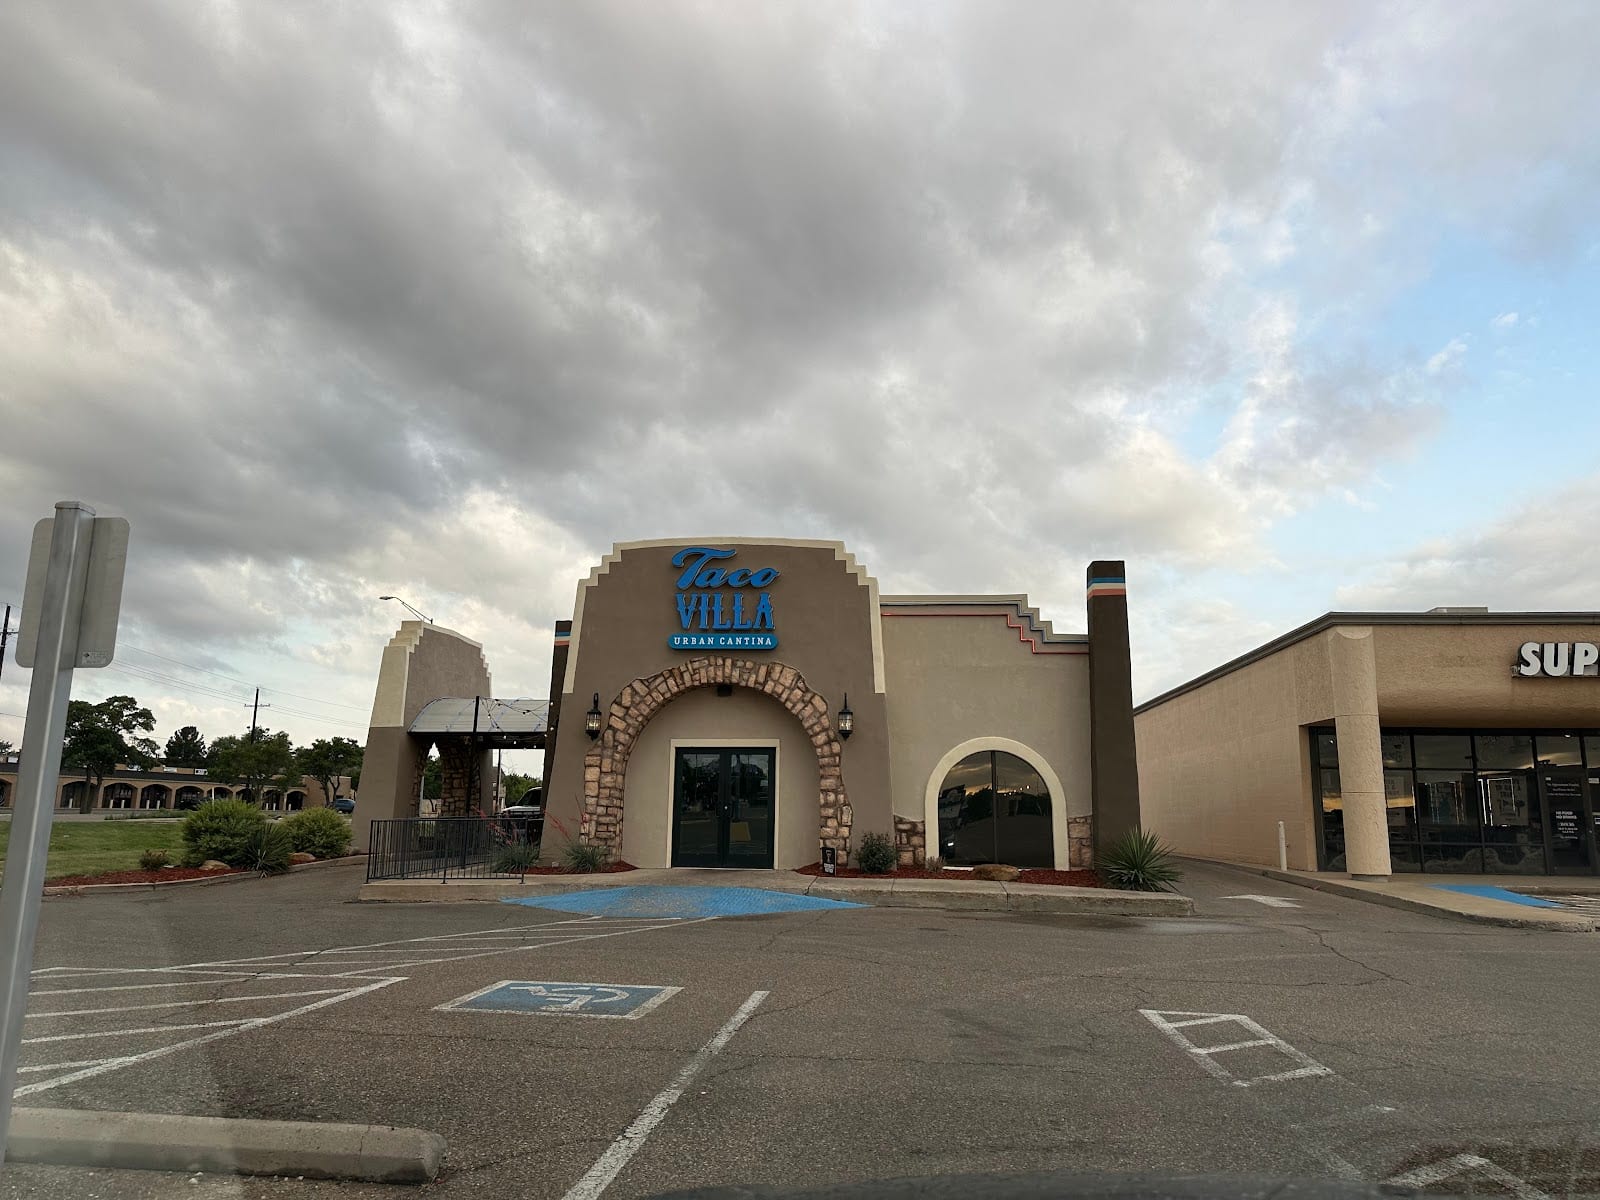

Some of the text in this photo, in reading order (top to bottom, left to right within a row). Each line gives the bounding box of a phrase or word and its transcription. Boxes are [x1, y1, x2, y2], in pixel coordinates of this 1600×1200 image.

[671, 547, 780, 590] Taco
[675, 592, 775, 630] VILLA
[673, 637, 772, 645] URBAN CANTINA
[1519, 642, 1599, 677] SUP
